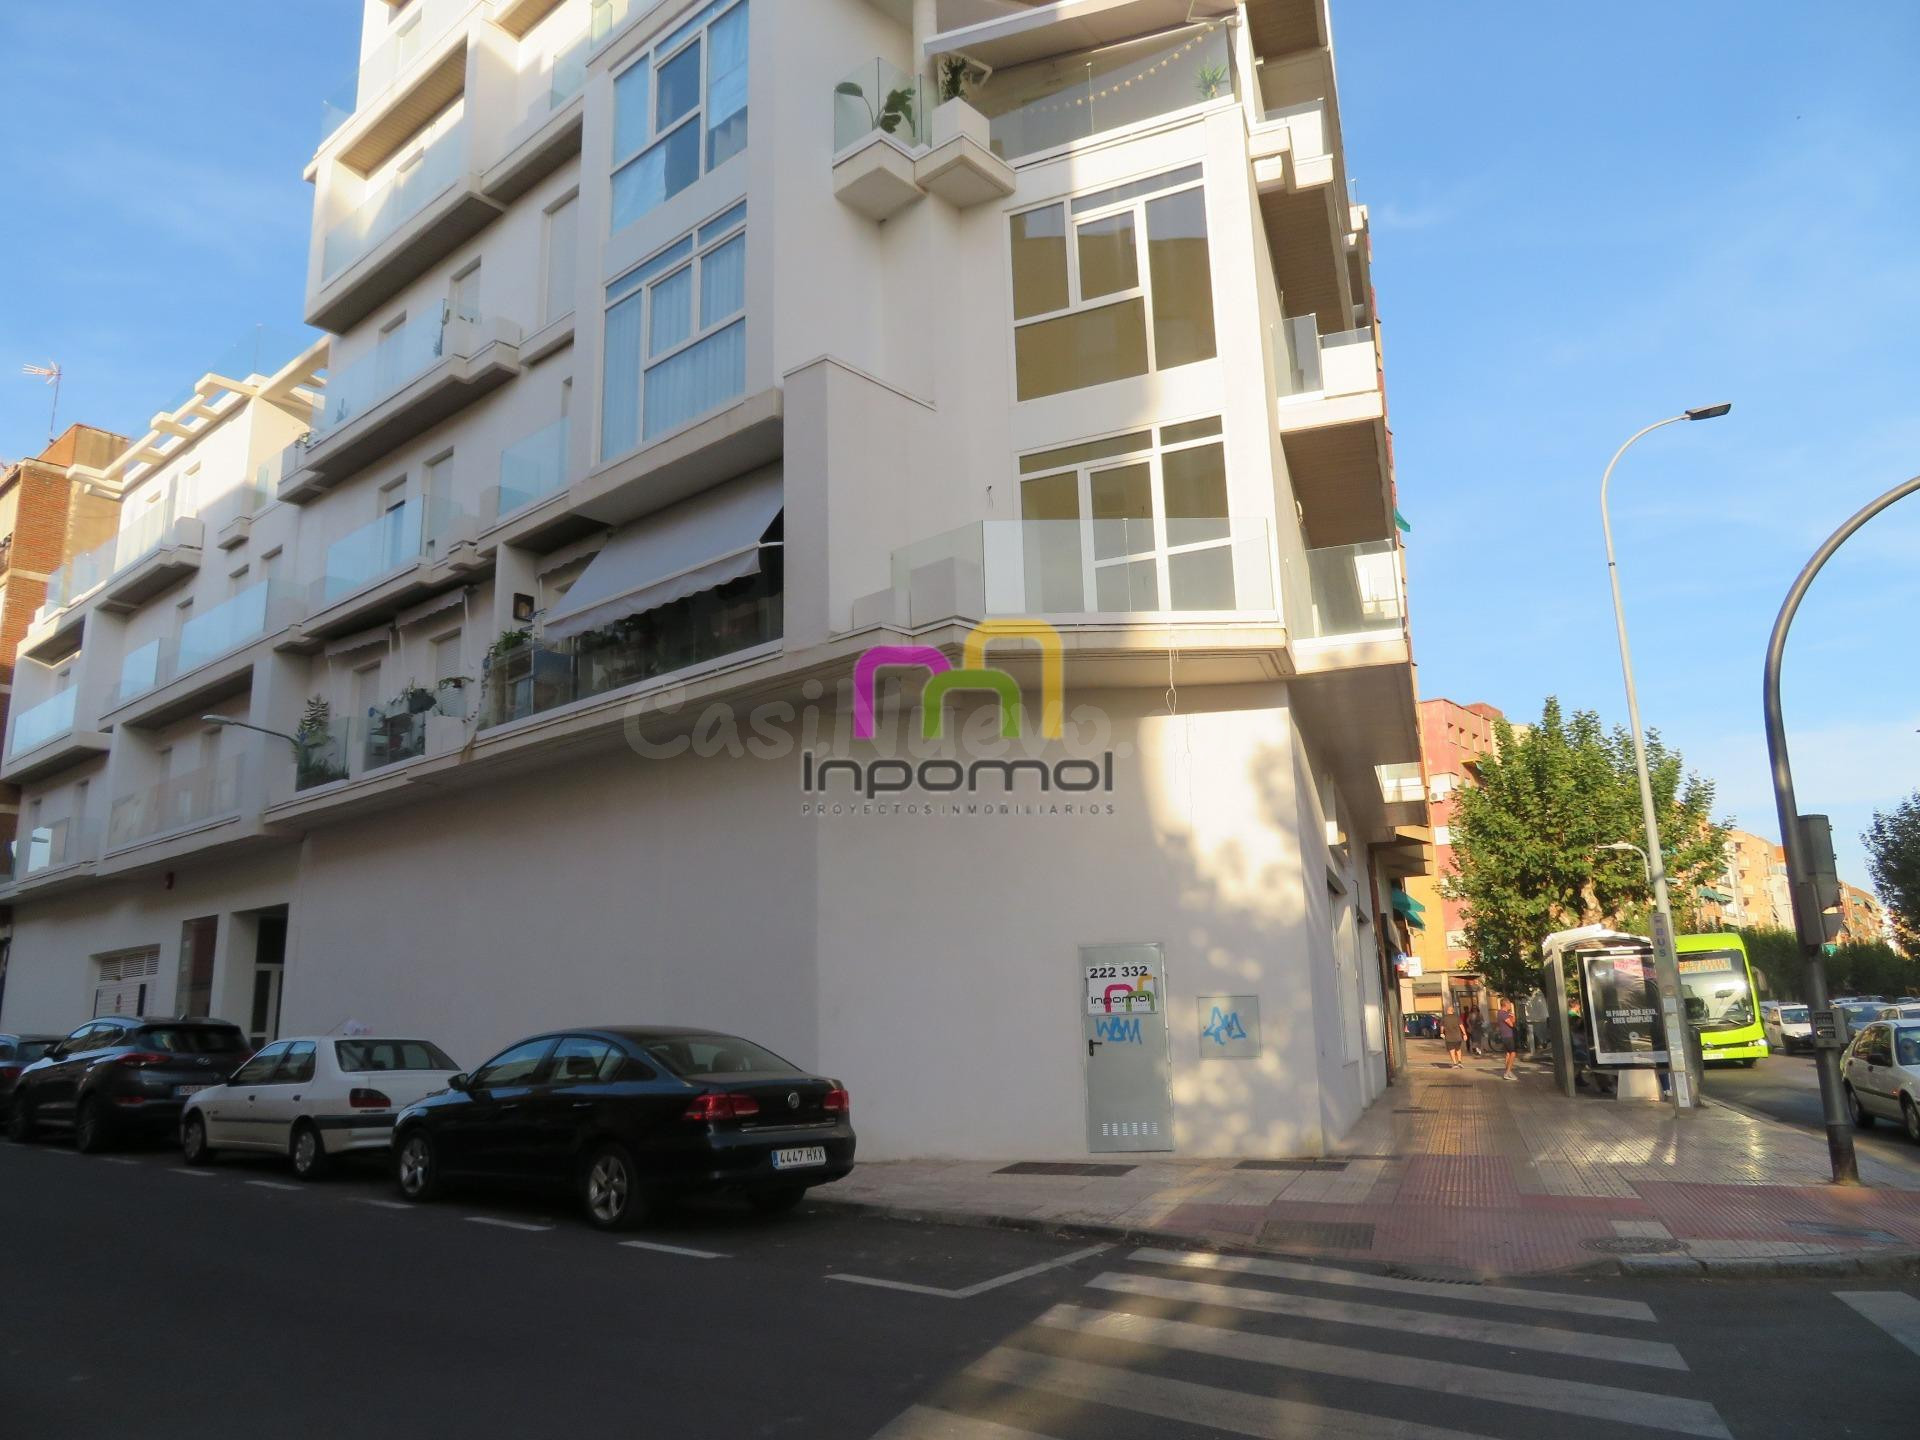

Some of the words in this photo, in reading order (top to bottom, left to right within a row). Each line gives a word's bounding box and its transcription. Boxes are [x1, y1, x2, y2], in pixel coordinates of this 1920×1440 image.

[1090, 967, 1116, 978] 222
[1121, 966, 1148, 977] 332
[780, 1150, 803, 1163] 4447
[806, 1147, 824, 1160] HXX
